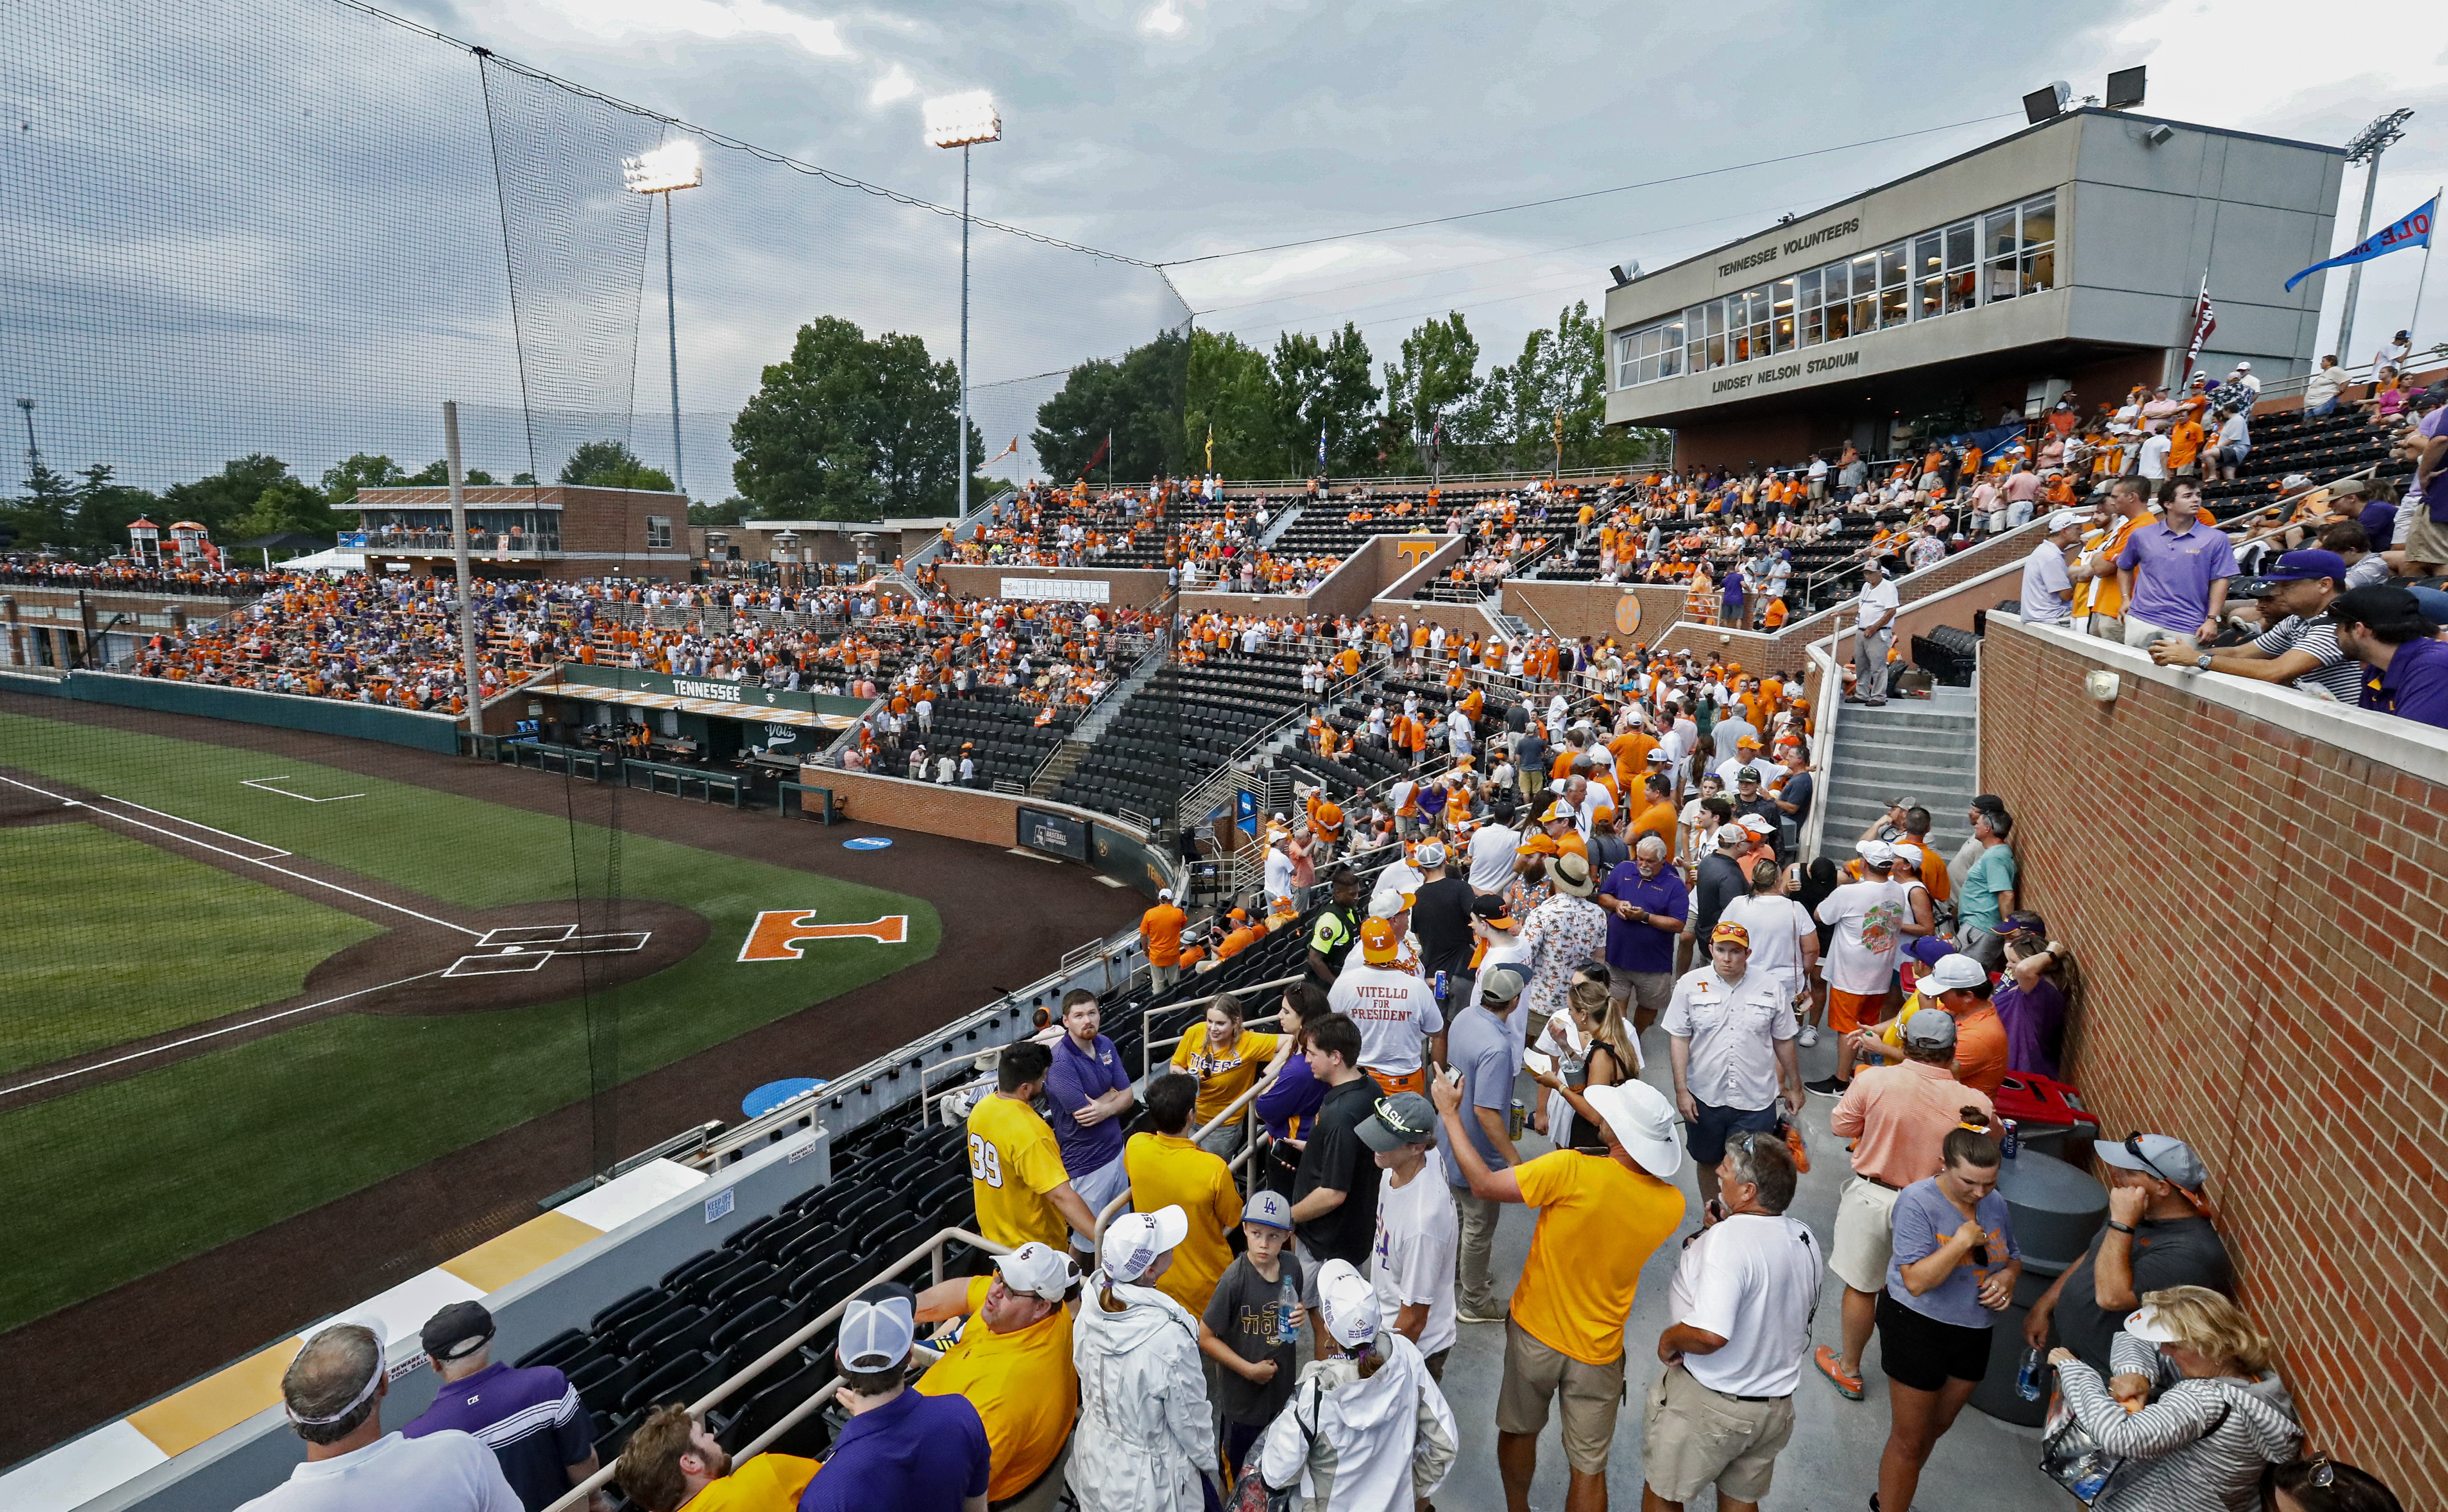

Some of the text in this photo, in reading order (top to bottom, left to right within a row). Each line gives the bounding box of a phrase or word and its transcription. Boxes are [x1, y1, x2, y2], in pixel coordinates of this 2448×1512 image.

[1718, 217, 1859, 277] TENNESSEE VOLUNTEERS
[1712, 351, 1859, 393] LINDSEY NELSON STADIUM
[1397, 541, 1436, 569] T
[672, 679, 741, 702] TENNESSEE
[1046, 830, 1067, 841] BASEBALL
[1499, 904, 1508, 917] T
[736, 909, 909, 962] T
[1372, 935, 1385, 948] T
[1356, 986, 1408, 999] VITELLO
[1697, 981, 1709, 993] T
[1373, 999, 1390, 1008] FOR
[1351, 1008, 1412, 1022] PRESIDENT
[1190, 1052, 1242, 1073] TIGERS
[791, 1146, 807, 1157] BEWARE
[802, 1147, 814, 1156] BALLS
[969, 1134, 1003, 1189] 39
[707, 1192, 731, 1211] KEEP OFF
[1263, 1197, 1277, 1215] LA
[709, 1202, 731, 1220] DUGOUT
[1973, 1270, 1989, 1285] T
[2129, 1312, 2142, 1324] T
[391, 1355, 421, 1374] BEWARE
[391, 1357, 429, 1380] FOUL BALL
